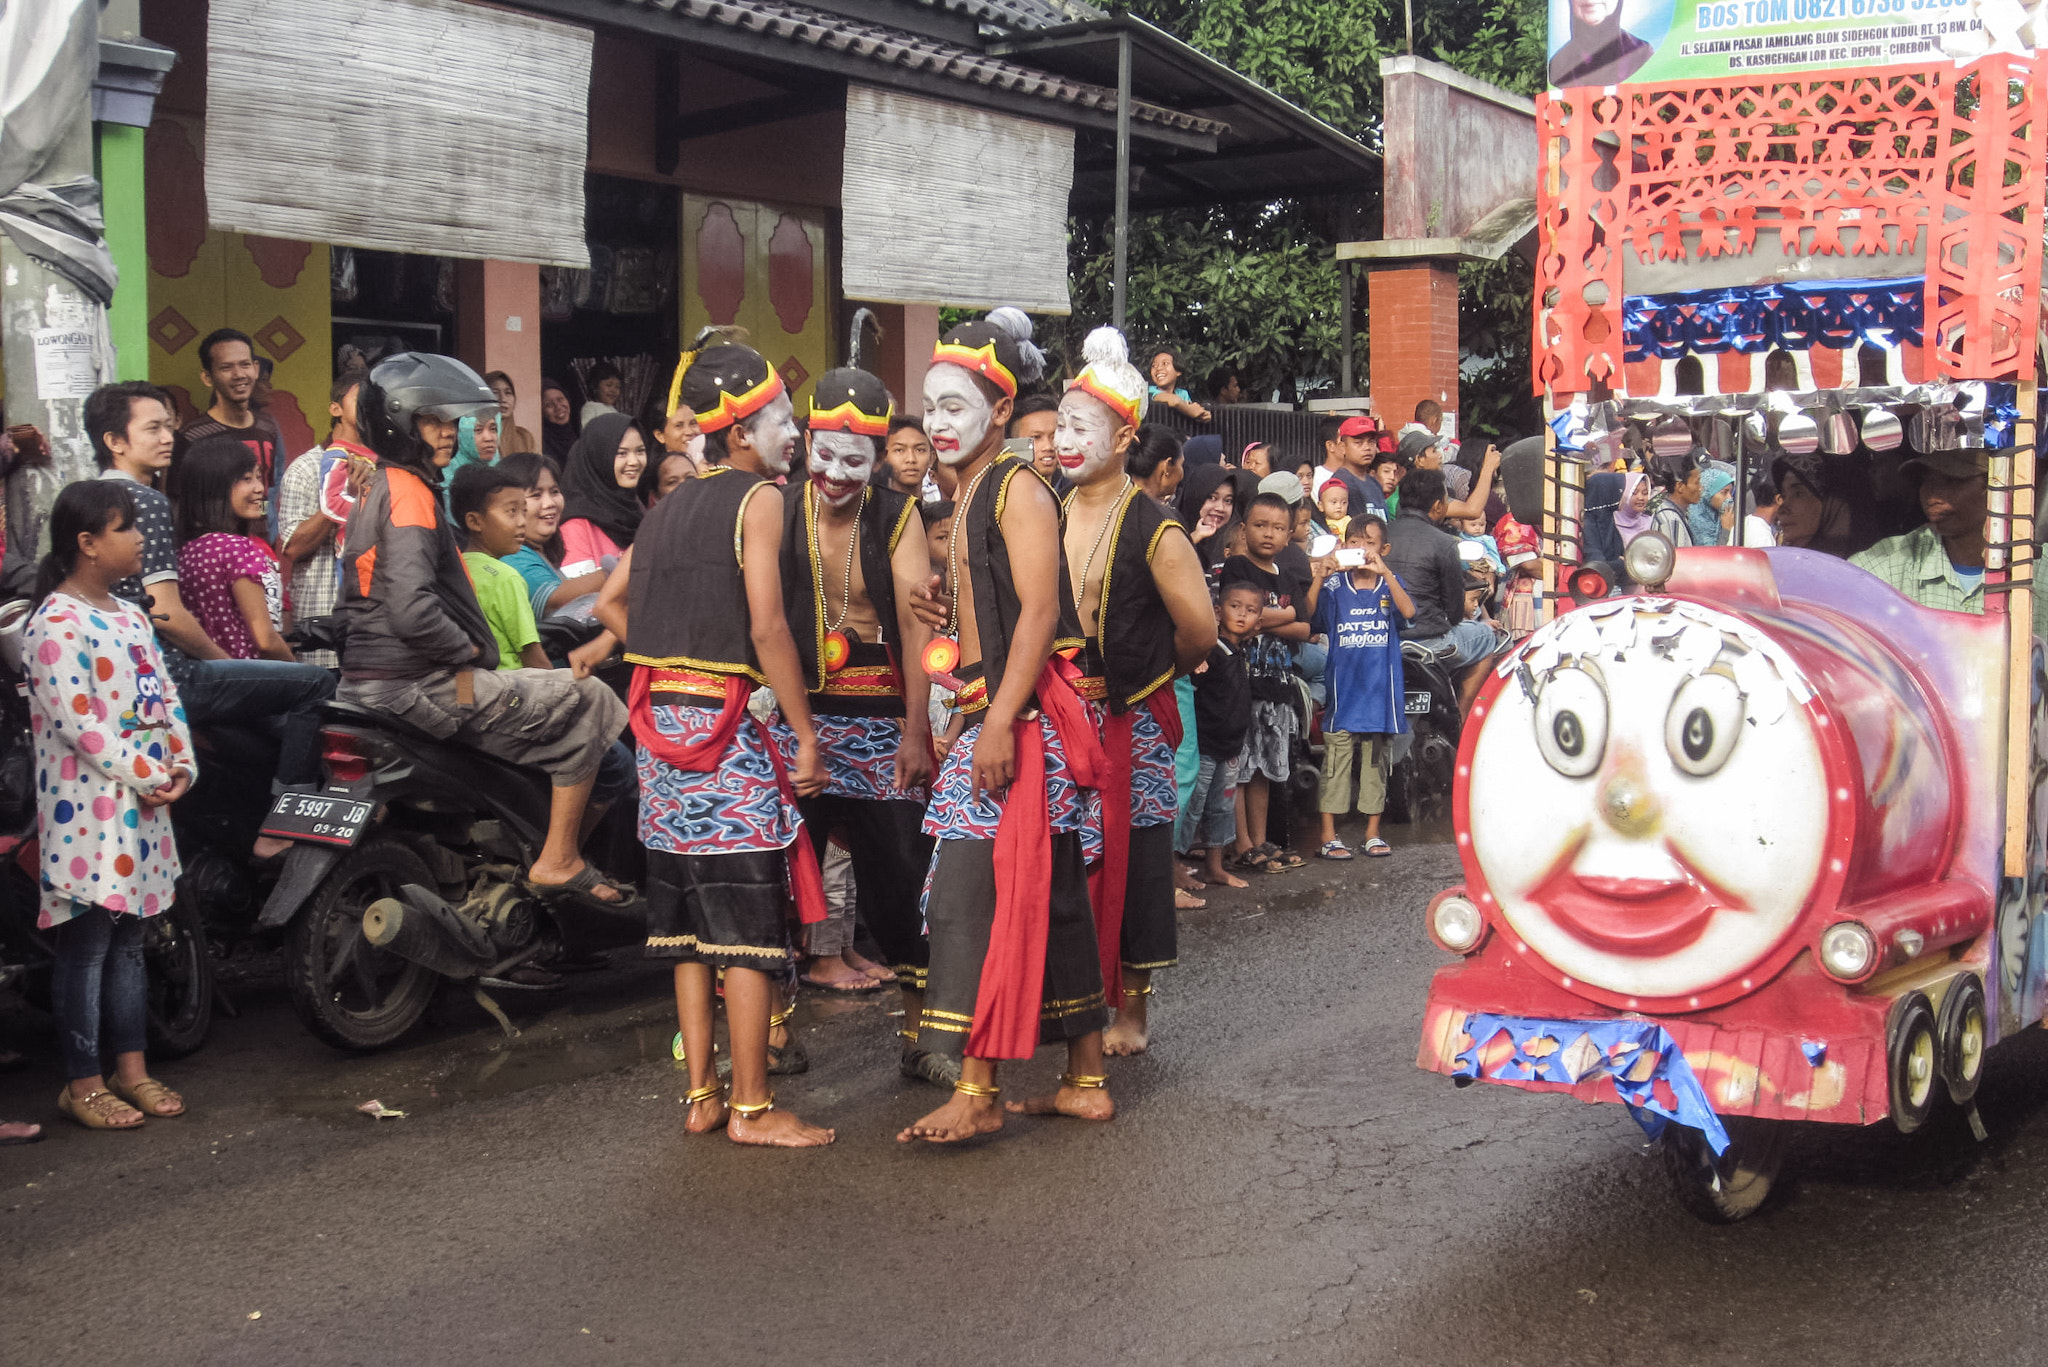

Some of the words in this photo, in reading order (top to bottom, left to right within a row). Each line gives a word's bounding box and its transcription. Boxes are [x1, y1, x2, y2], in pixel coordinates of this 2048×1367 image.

[1699, 4, 1738, 28] BOS
[1746, 0, 1788, 23] TOM
[1681, 44, 1691, 55] JL.
[1694, 40, 1731, 54] SELATAN
[1733, 38, 1763, 51] PASAR
[1765, 33, 1813, 48] JAMBLANG
[1816, 32, 1839, 45] BLOK
[1842, 27, 1888, 42] SIDENGOK
[1891, 25, 1918, 38] KIDUL
[1921, 23, 1934, 35] RT.
[1937, 22, 1947, 34] 13
[1950, 20, 1968, 33] RW.
[1970, 18, 1983, 31] 04
[1729, 56, 1744, 68] DS.
[1746, 52, 1807, 67] KASUGENGAN
[1810, 50, 1826, 61] LOR
[1829, 48, 1849, 60] KEC.
[1851, 45, 1882, 58] DEPOK
[1889, 41, 1931, 56] CIREBON
[1337, 620, 1390, 633] DATSUN
[1339, 632, 1389, 648] Indofood
[276, 798, 292, 814] E
[295, 799, 333, 818] 5997
[342, 806, 366, 824] JB
